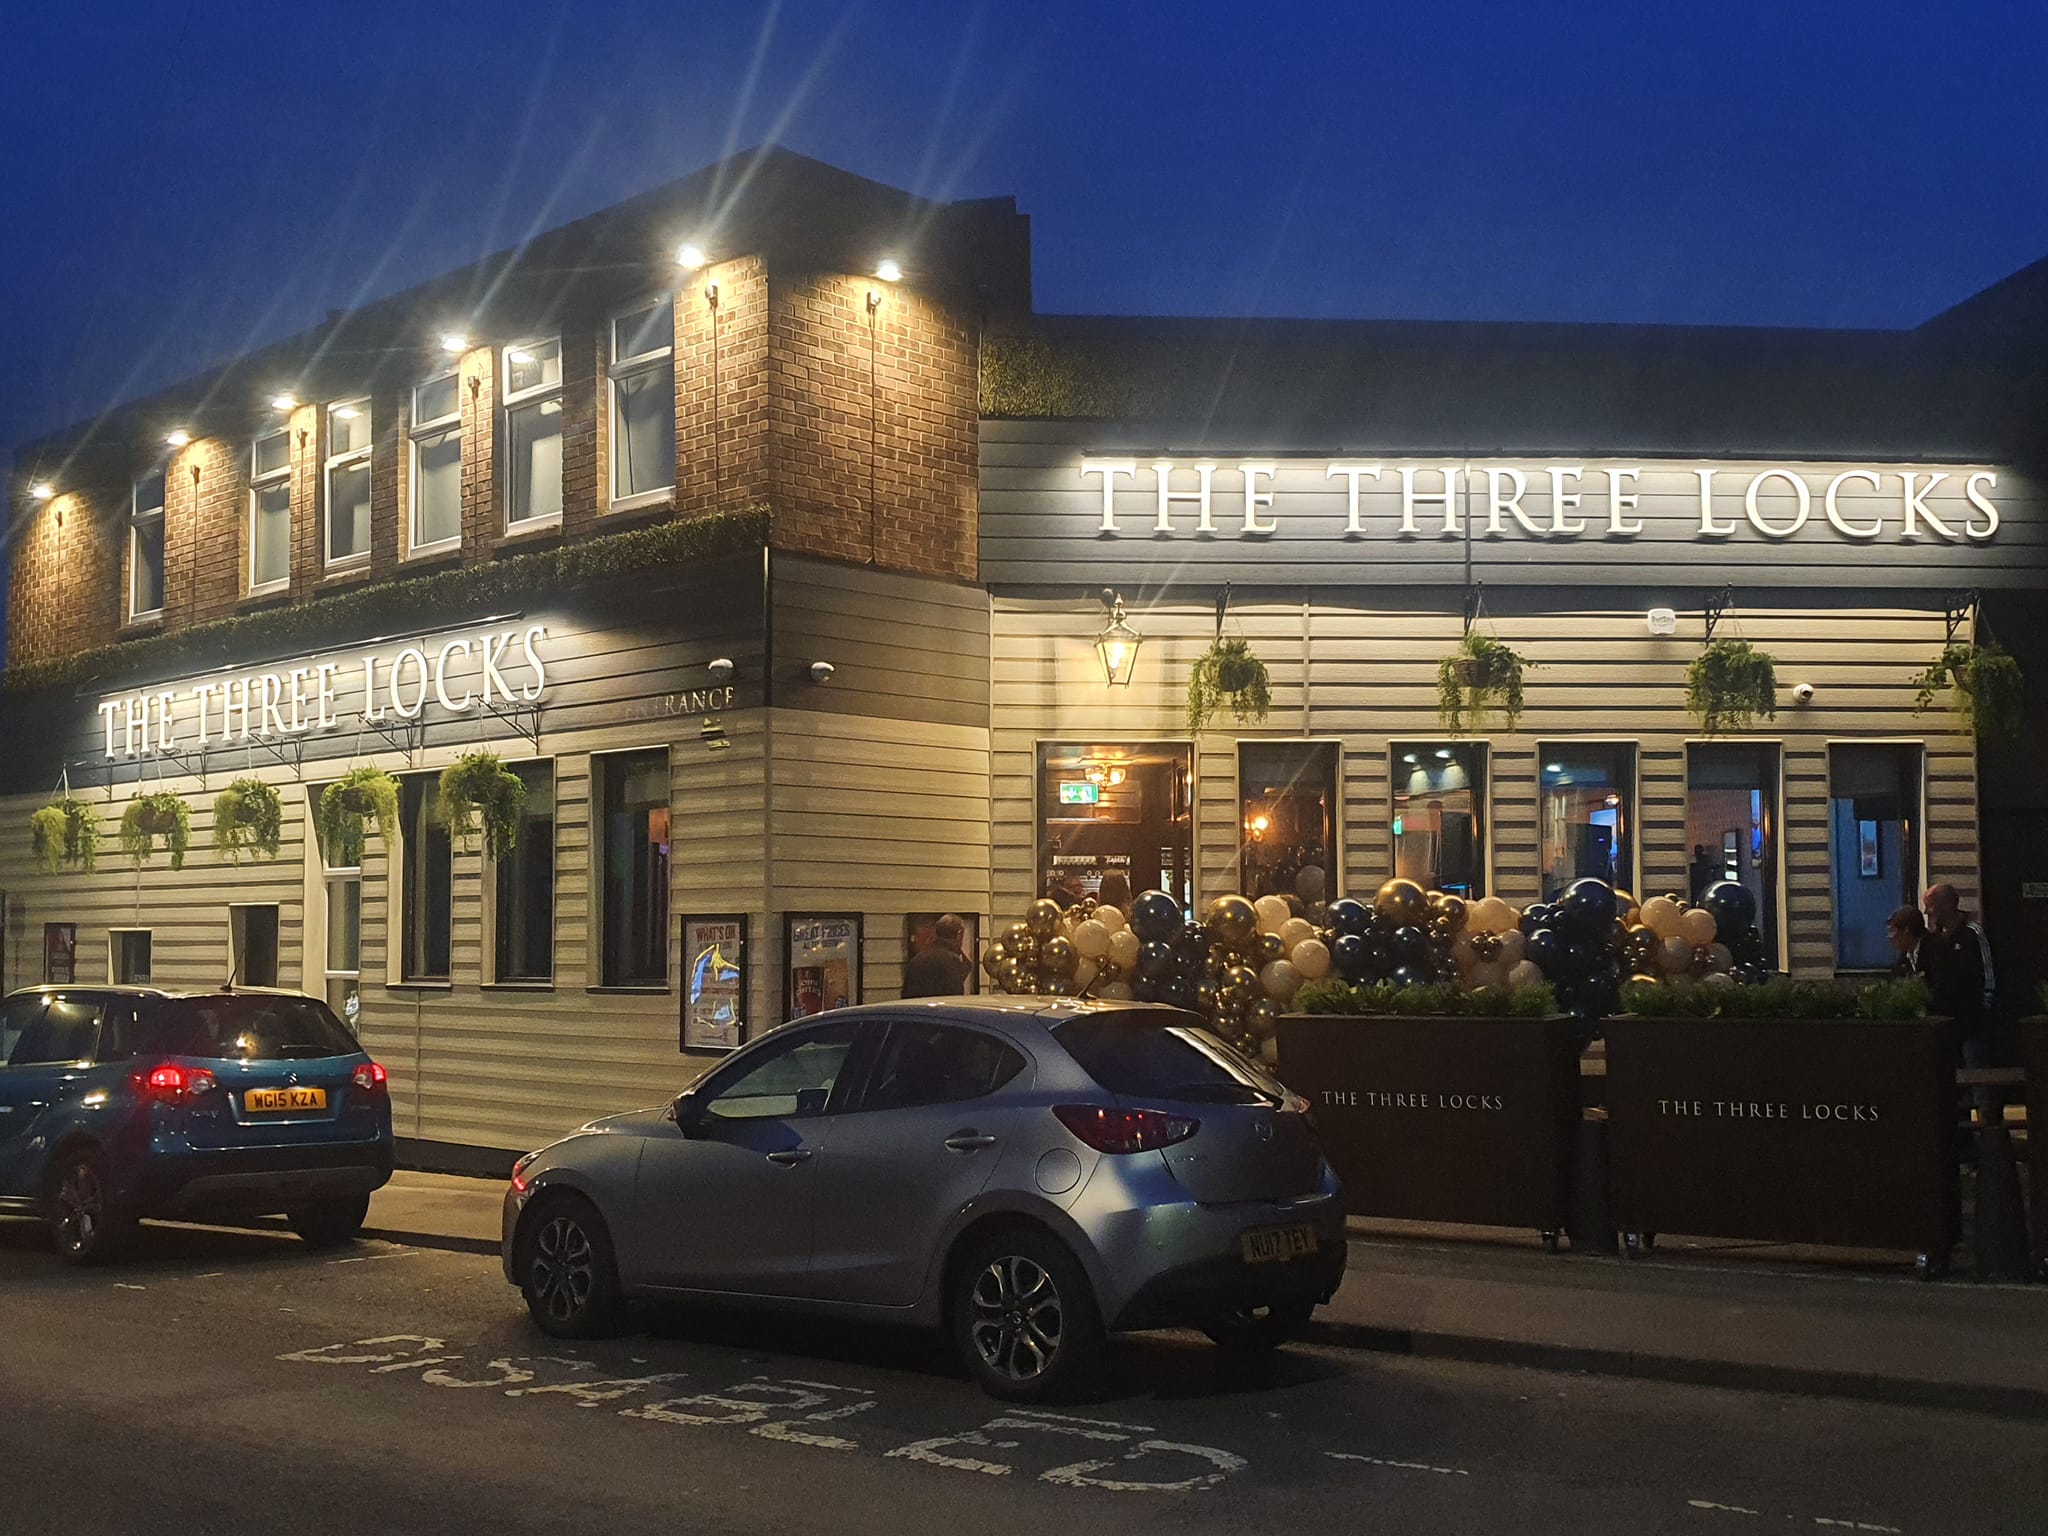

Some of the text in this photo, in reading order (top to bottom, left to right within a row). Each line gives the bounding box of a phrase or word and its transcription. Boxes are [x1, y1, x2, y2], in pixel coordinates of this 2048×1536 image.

[1080, 457, 2000, 538] THE THREE LOCKS
[98, 625, 546, 758] THE THREE LOCKS
[253, 1091, 318, 1108] WG15 KZA
[1321, 1091, 1503, 1110] THE THREE LOCKS
[1658, 1100, 1879, 1121] THE THREE LOCKS
[275, 1333, 1250, 1493] DISABLED
